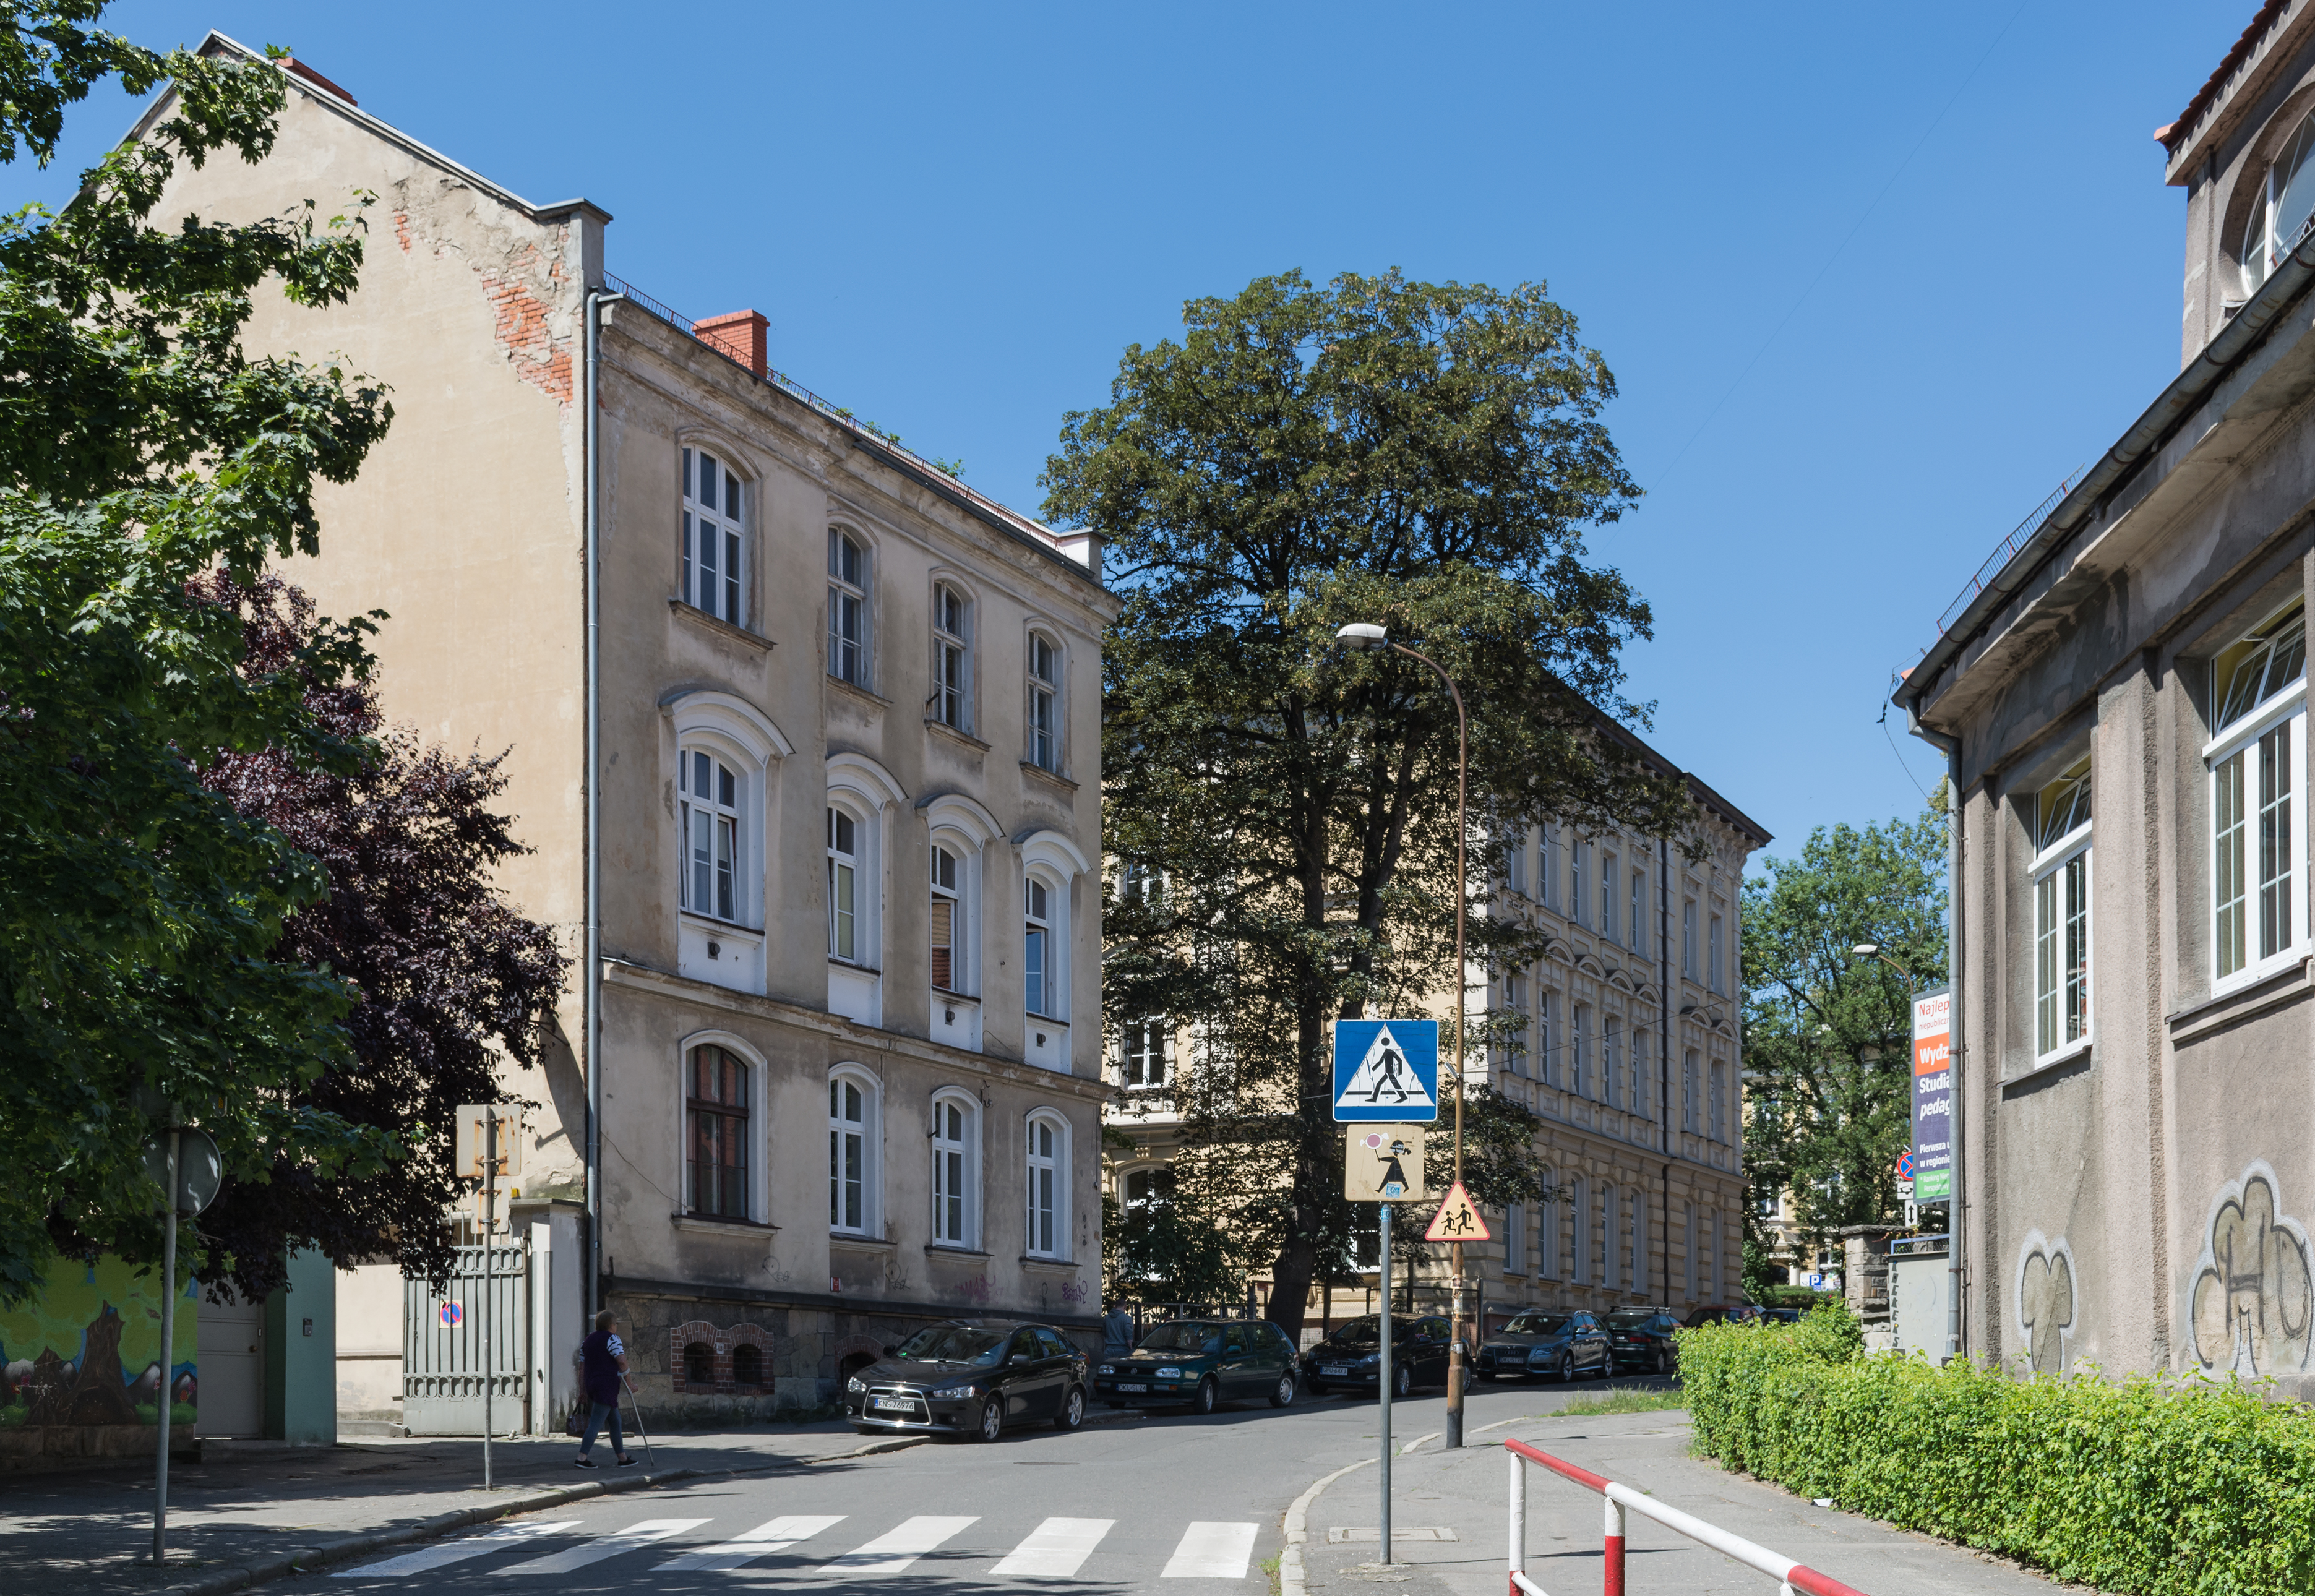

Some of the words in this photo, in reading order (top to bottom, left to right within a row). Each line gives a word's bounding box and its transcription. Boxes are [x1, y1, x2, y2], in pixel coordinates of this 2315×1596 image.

[1919, 1000, 1949, 1017] Najlep
[1920, 1141, 1946, 1154] Pierwsza
[1920, 1160, 1926, 1168] w
[1926, 1154, 1950, 1168] regionie
[1811, 1275, 1820, 1286] P
[878, 1399, 891, 1408] KNS
[893, 1401, 914, 1410] 76976
